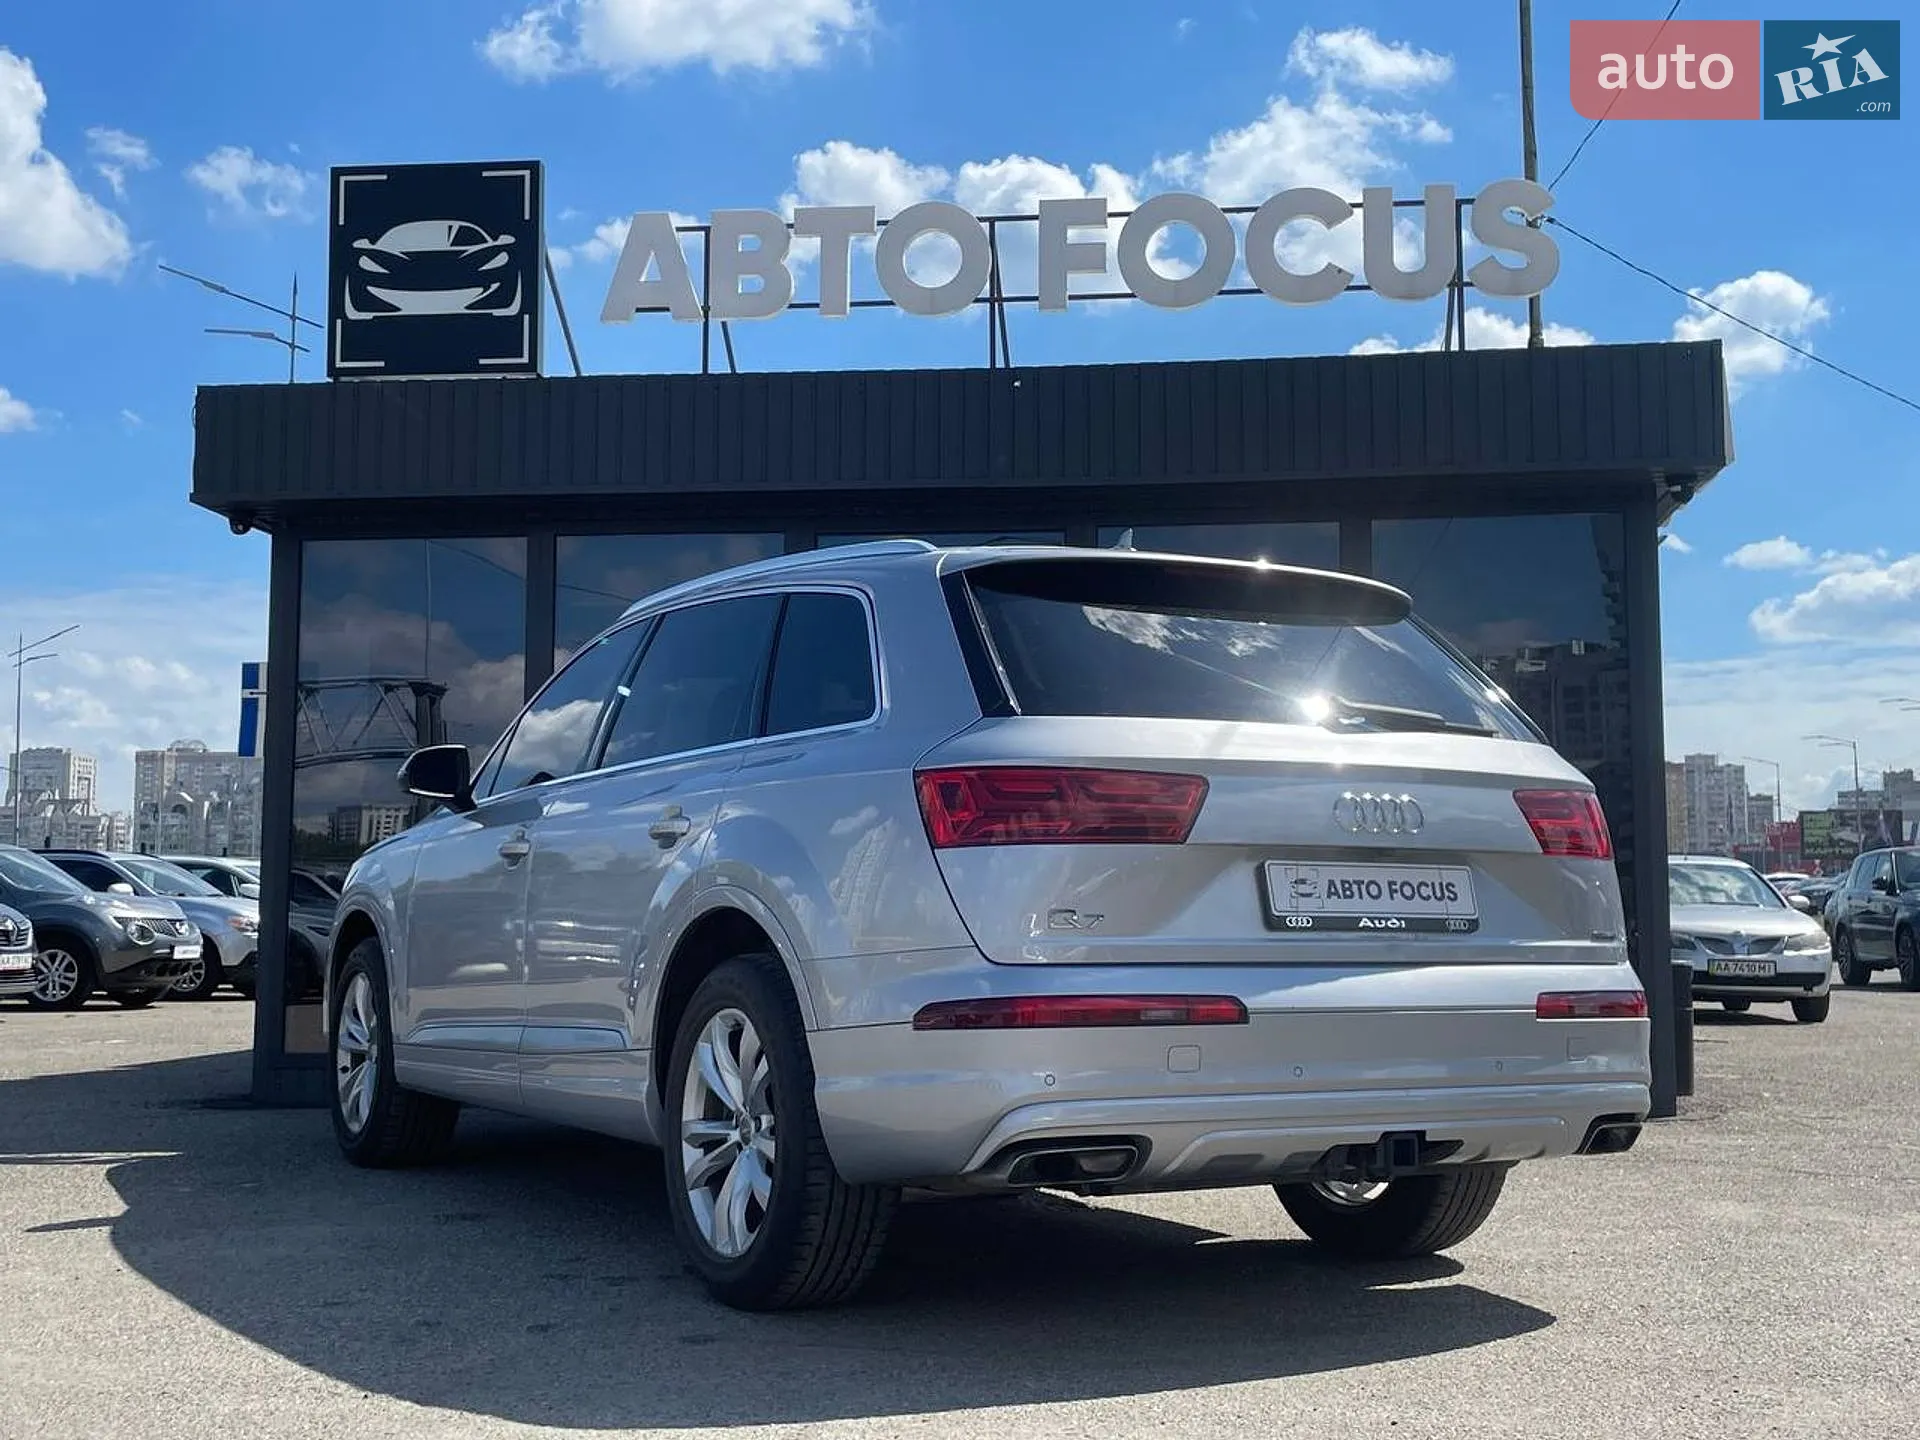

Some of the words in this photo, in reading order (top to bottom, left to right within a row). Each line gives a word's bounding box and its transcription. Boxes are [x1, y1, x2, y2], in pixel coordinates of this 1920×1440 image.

[1038, 179, 1560, 312] FOCUS
[1387, 881, 1459, 901] FOCUS
[1047, 909, 1104, 929] Q7
[1358, 917, 1406, 929] Audi
